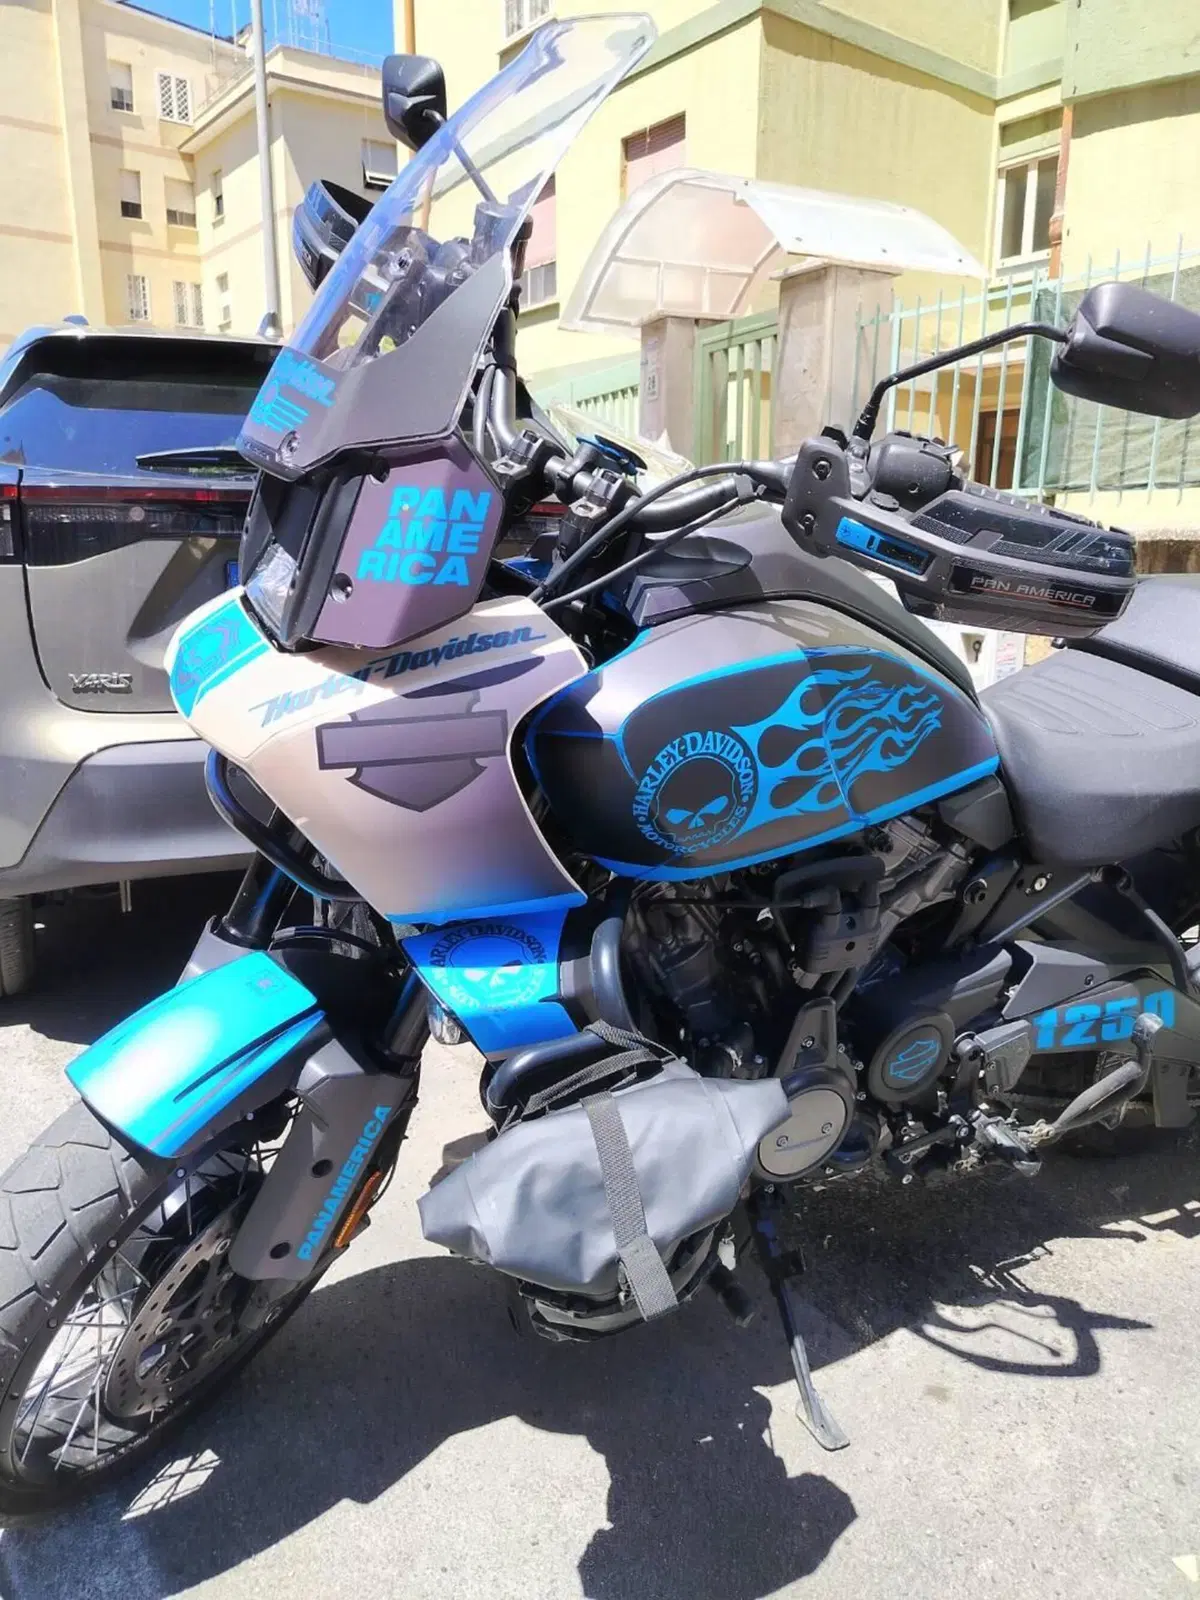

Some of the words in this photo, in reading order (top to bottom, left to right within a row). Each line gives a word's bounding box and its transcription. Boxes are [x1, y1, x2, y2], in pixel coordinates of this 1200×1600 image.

[389, 486, 491, 522] PAN
[375, 519, 483, 554] AME
[357, 550, 469, 586] RICA
[971, 576, 1010, 591] PAN
[1016, 584, 1096, 605] AMERICA
[249, 626, 547, 728] Harley-Davidson
[1033, 989, 1176, 1049] 1250
[296, 1104, 392, 1261] PANAMERICA
